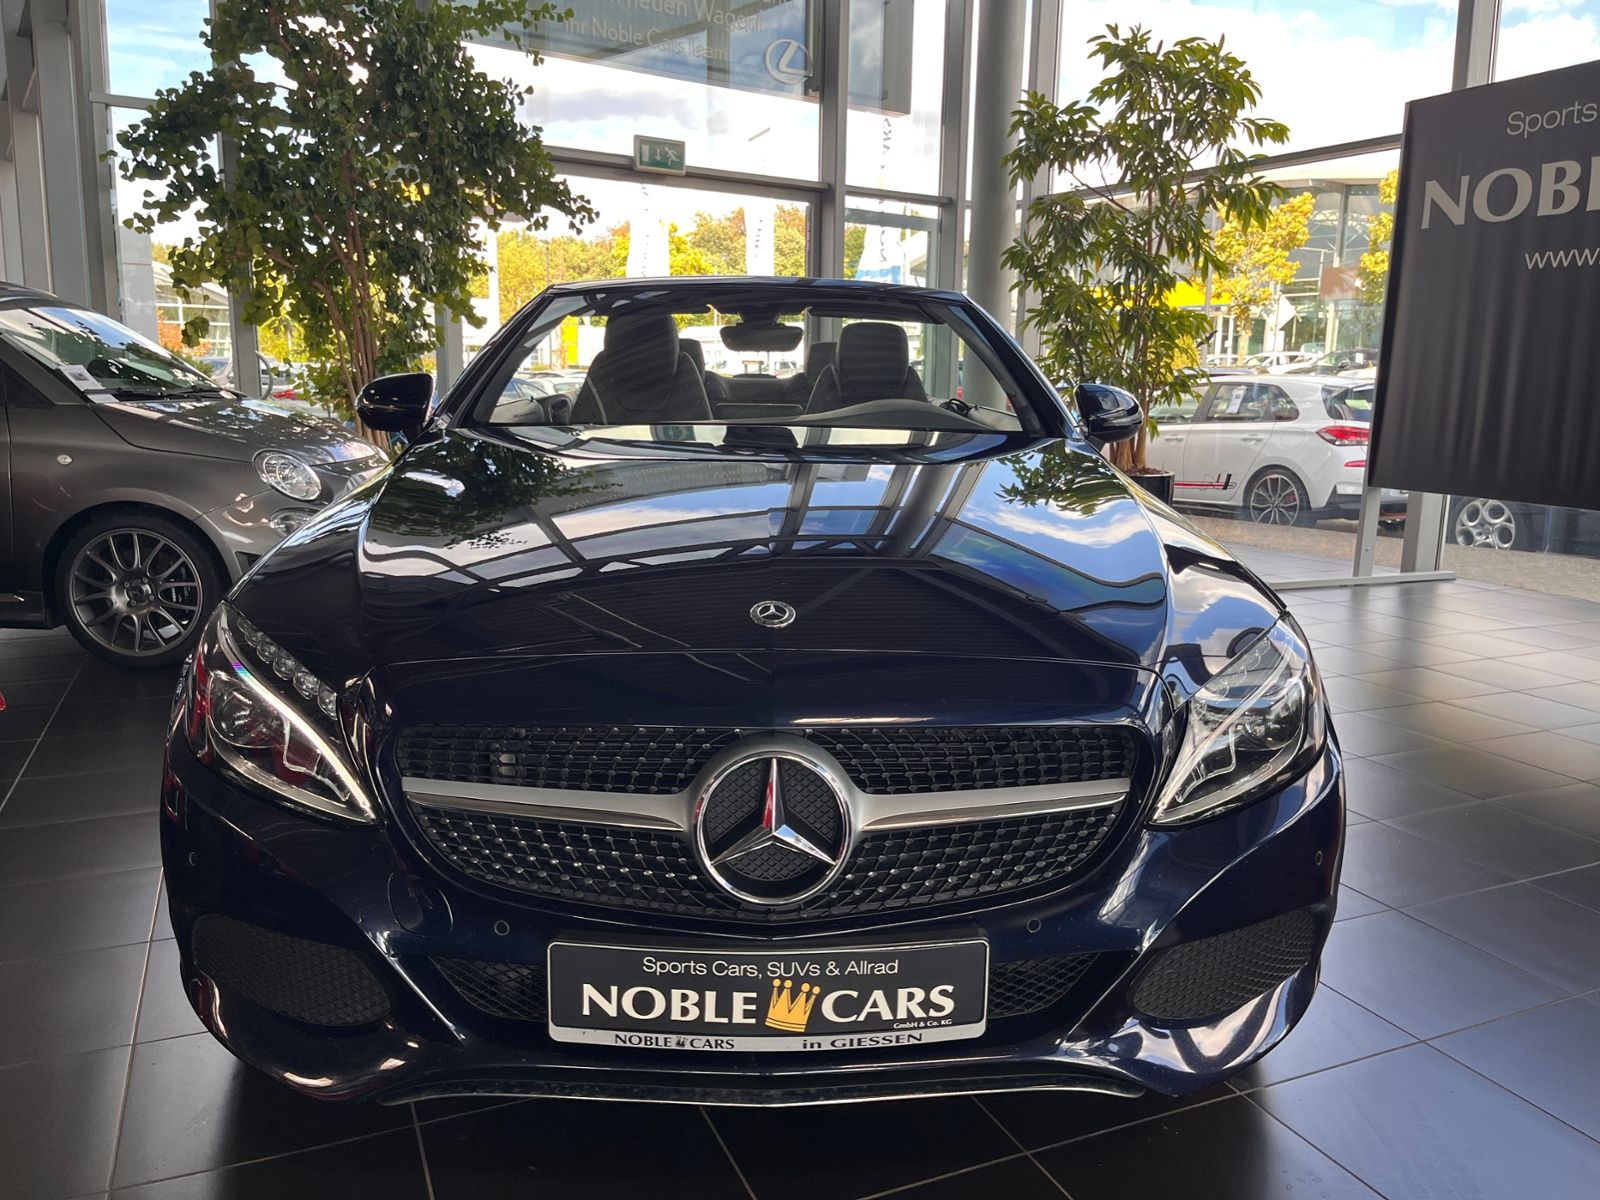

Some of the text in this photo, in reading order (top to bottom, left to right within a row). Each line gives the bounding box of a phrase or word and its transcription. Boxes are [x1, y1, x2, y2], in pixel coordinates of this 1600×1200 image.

[592, 16, 643, 45] Noble
[1506, 101, 1598, 138] Sports
[643, 957, 899, 979] Sports Cars, SUVs & Allrad
[582, 983, 955, 1024] NOBLE CARS
[893, 1021, 918, 1029] GmbH
[614, 1032, 923, 1050] NOBLE CARS in GIESSEN
